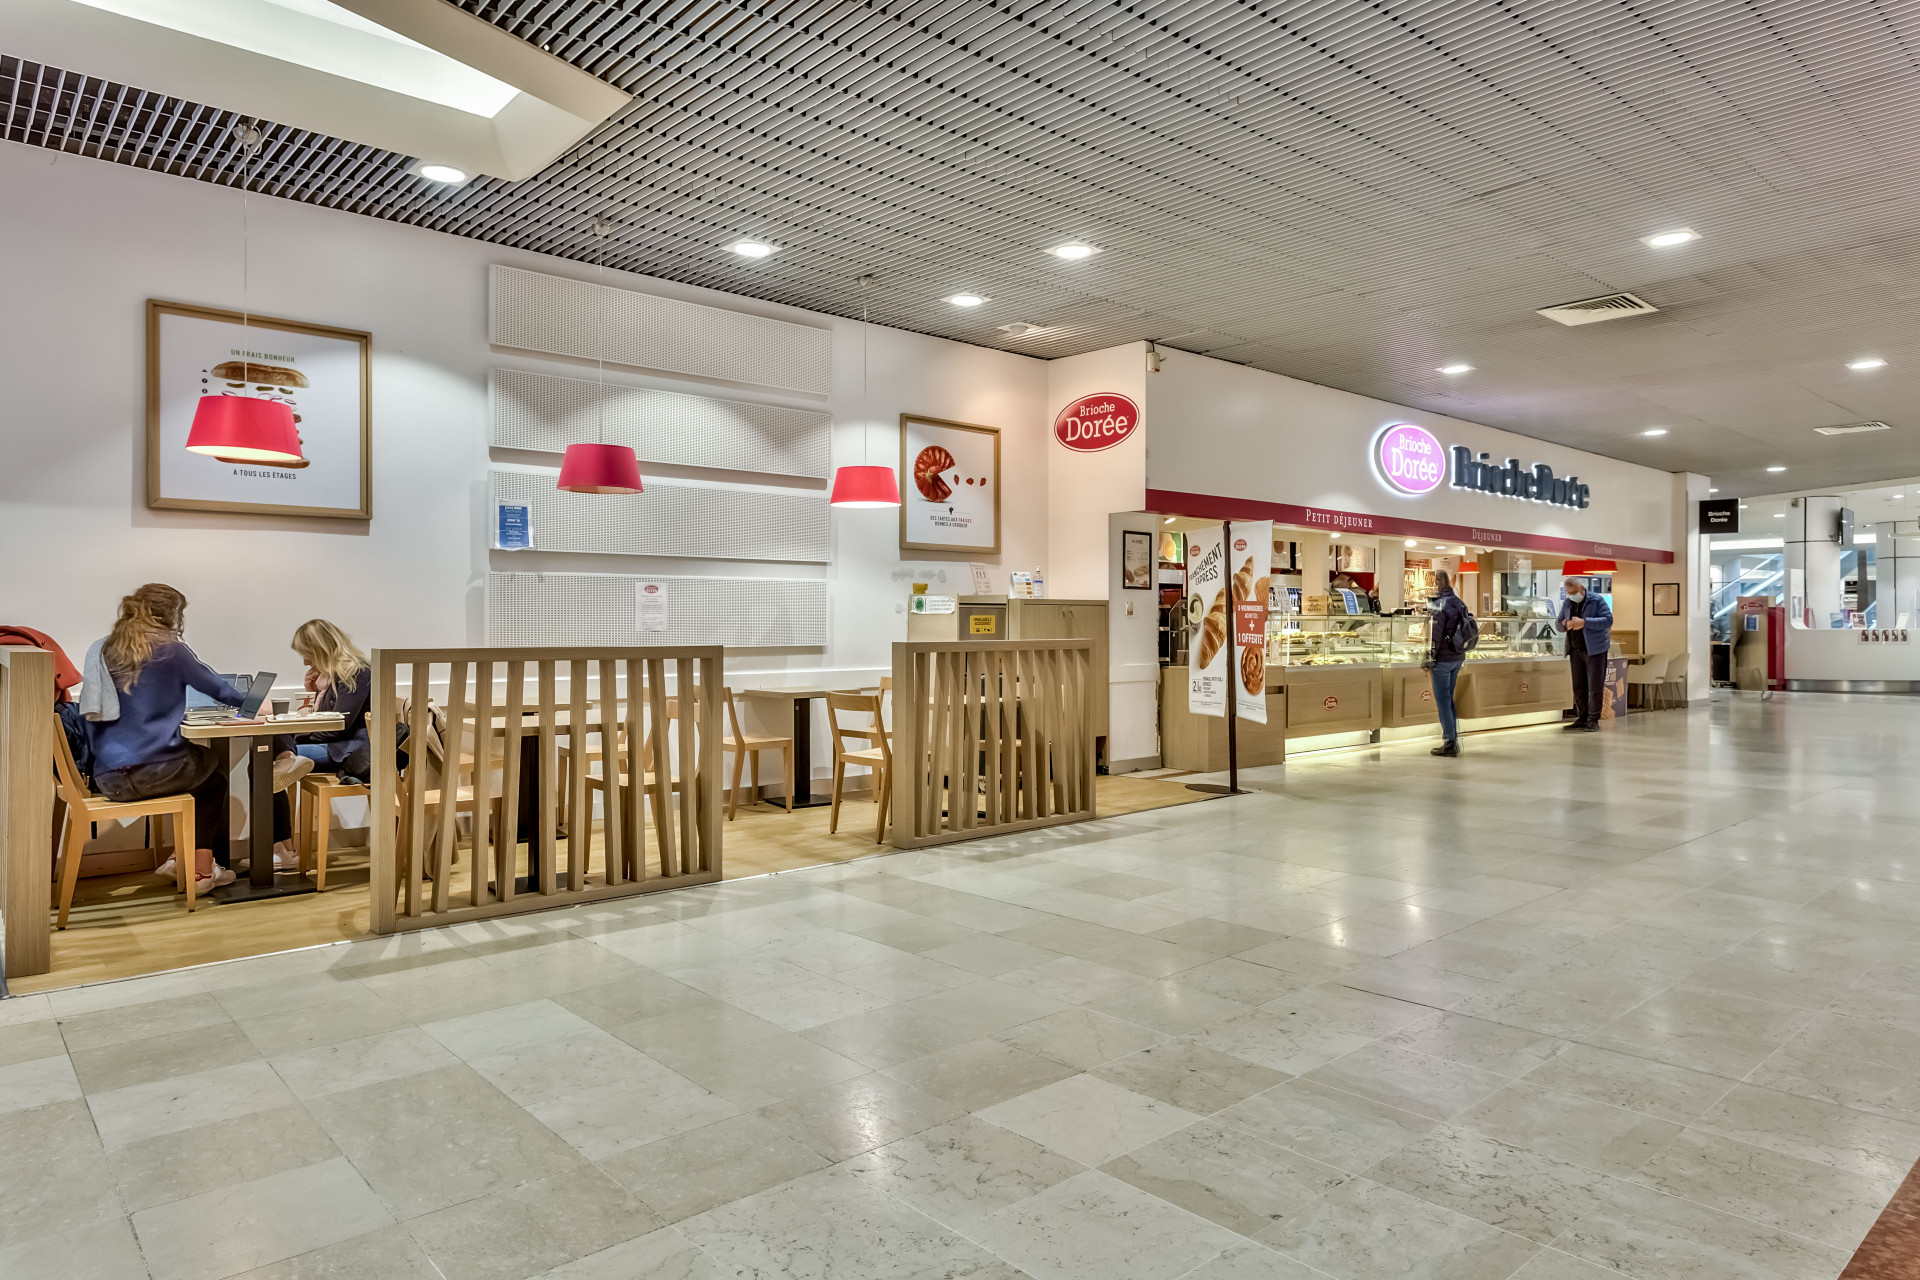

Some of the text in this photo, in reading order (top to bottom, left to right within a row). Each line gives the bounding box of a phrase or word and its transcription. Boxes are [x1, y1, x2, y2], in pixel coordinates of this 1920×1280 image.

[242, 350, 262, 358] FRAIS
[1080, 402, 1116, 416] Brioche
[1066, 414, 1128, 442] Dorée
[1399, 433, 1432, 455] Brioche
[1391, 447, 1438, 482] Dorée
[1189, 542, 1222, 581] FRANCHEMENT
[1195, 565, 1218, 586] EXPRESS
[1238, 632, 1263, 644] 1 OFFERTE
